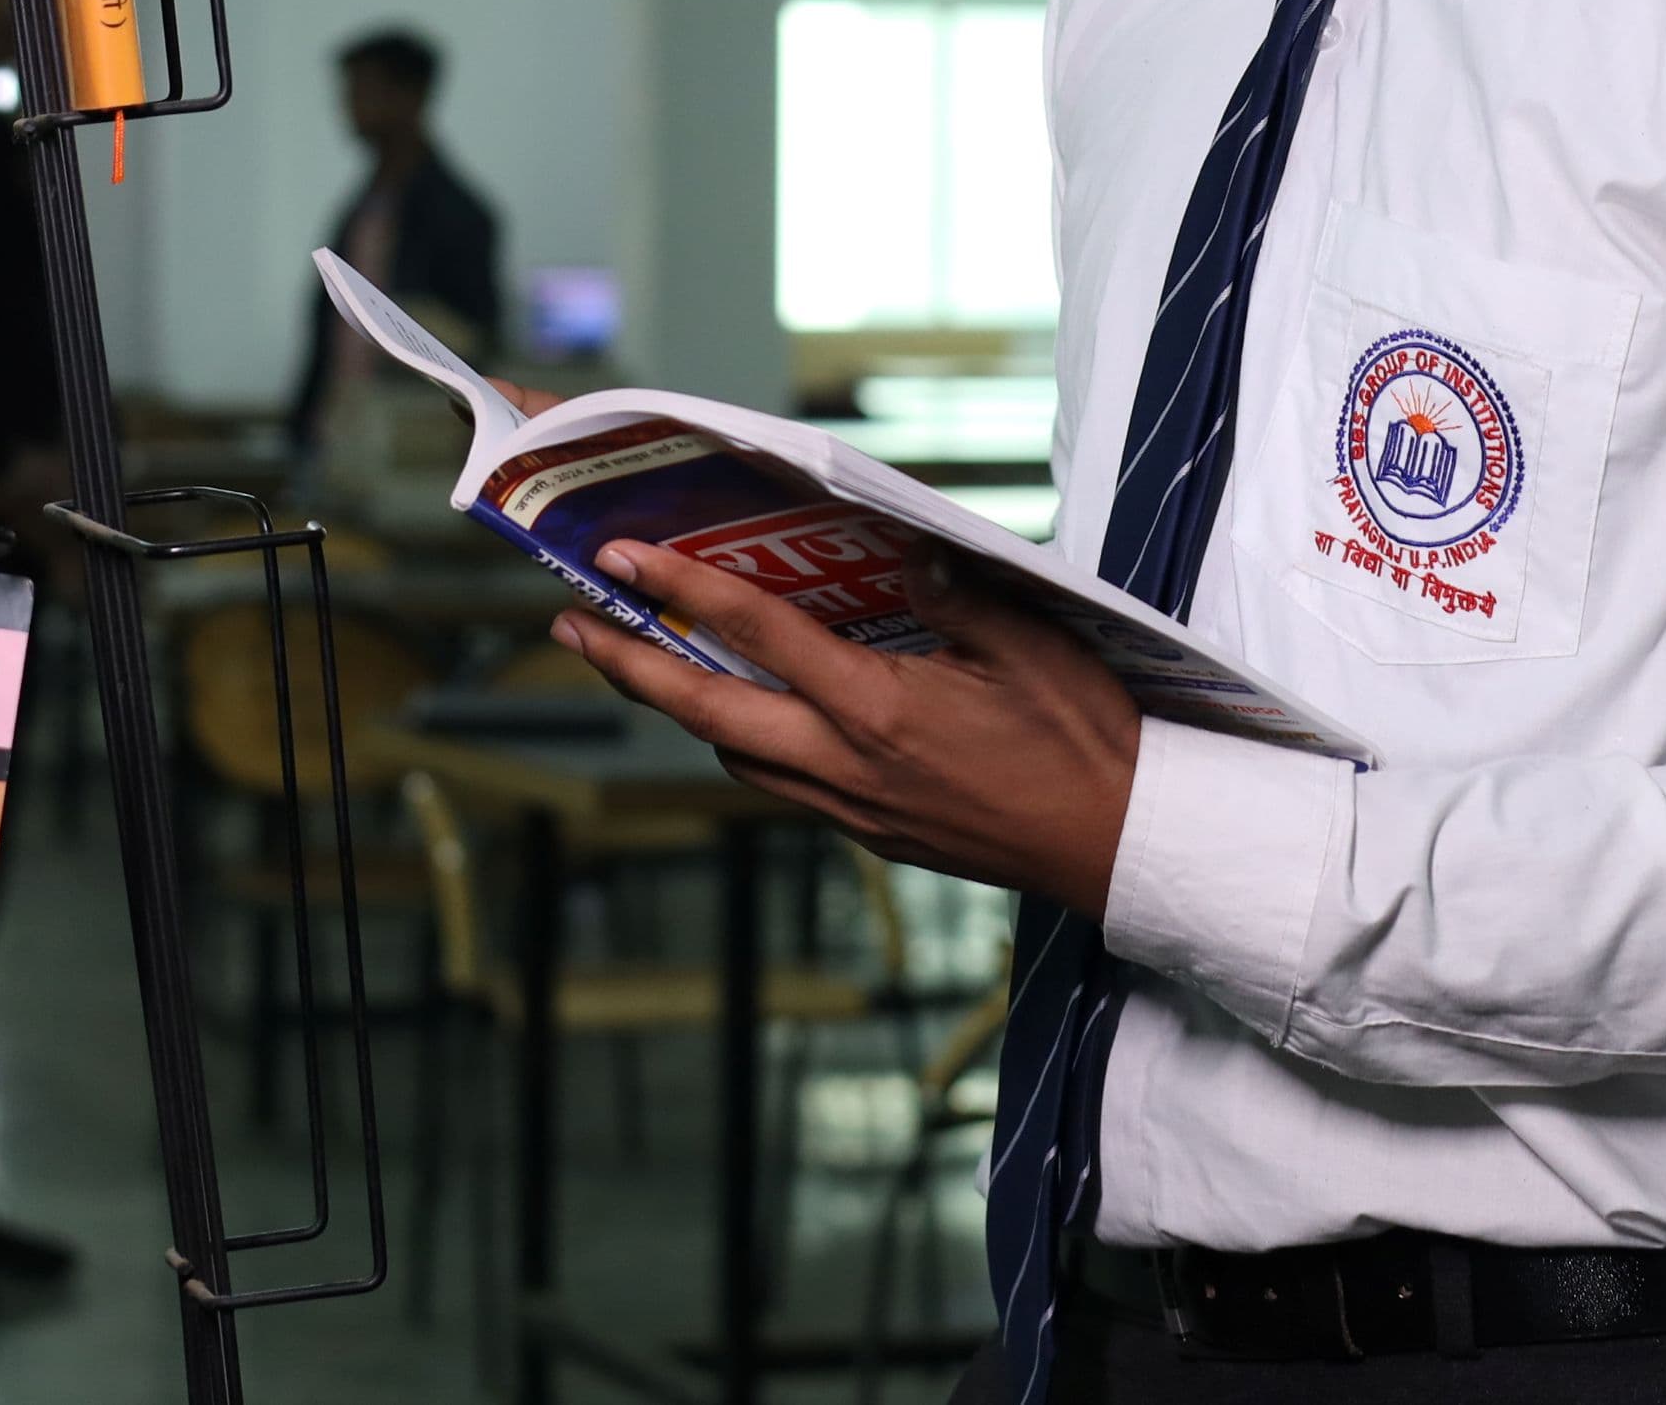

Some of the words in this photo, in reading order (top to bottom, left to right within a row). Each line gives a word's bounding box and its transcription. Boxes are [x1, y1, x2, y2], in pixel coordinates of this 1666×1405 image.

[1358, 350, 1409, 407] GROUP
[1415, 350, 1440, 373] OF
[1442, 361, 1507, 512] INSTITUTIONS
[554, 468, 585, 484] 2024
[1334, 474, 1404, 566] PRAYAGRAJ
[1315, 530, 1336, 556] सा
[1389, 564, 1412, 591] या
